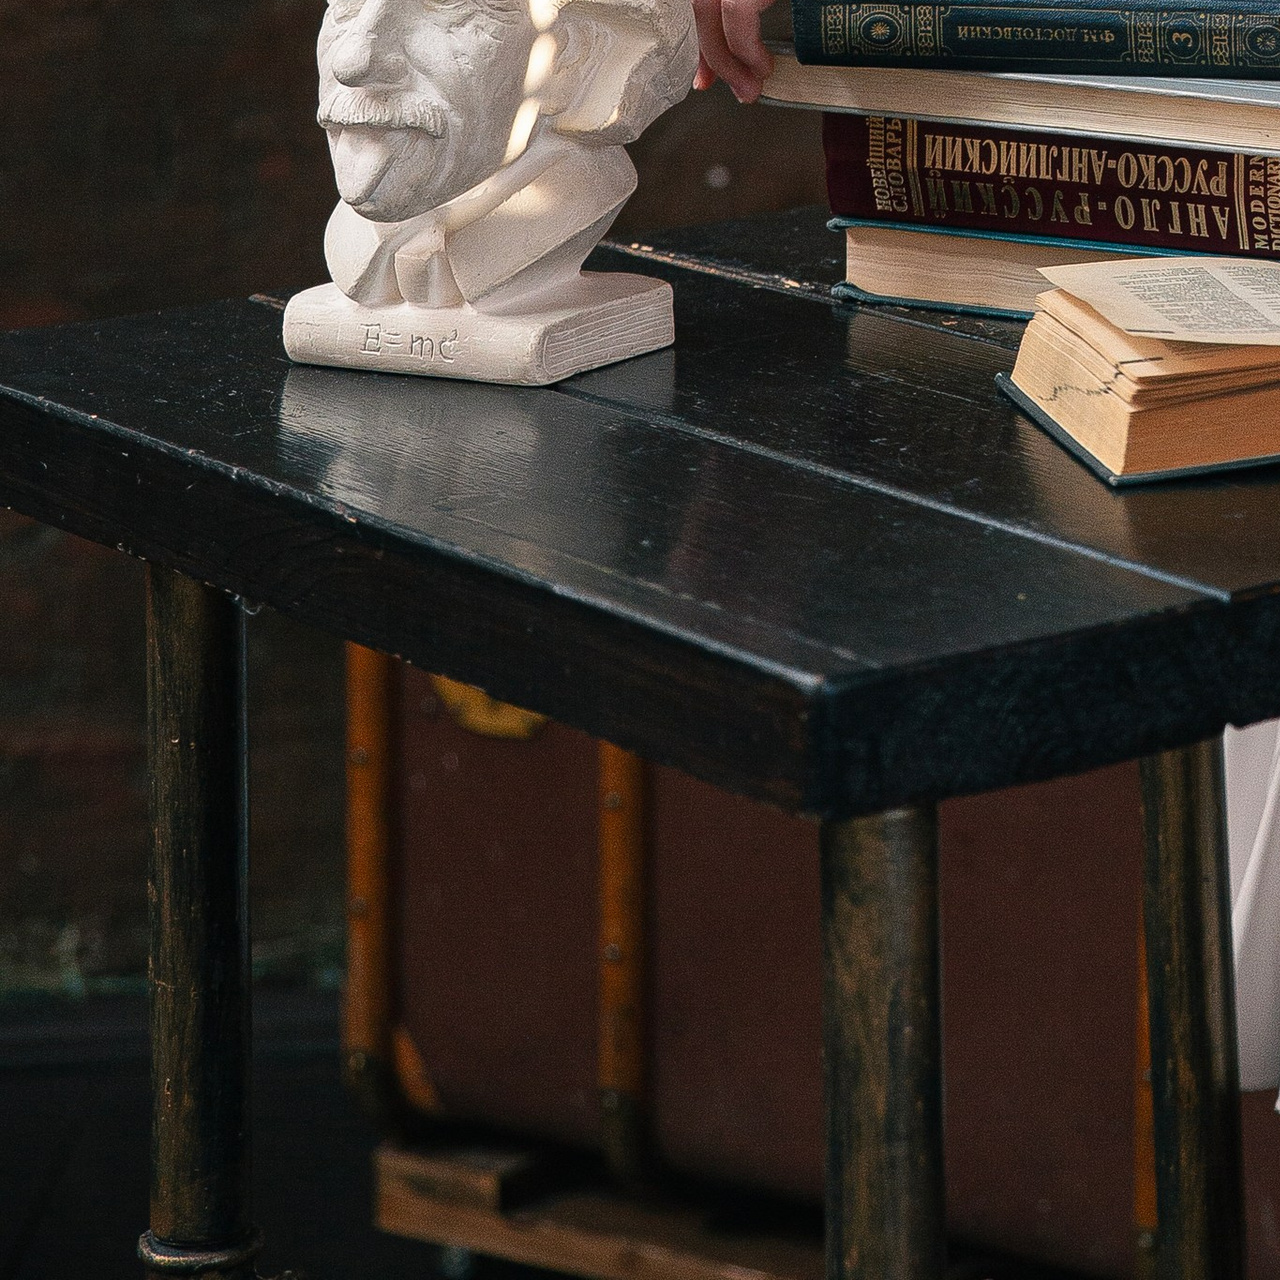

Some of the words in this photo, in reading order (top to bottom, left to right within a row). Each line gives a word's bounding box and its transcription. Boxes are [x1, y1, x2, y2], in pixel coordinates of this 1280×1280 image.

[957, 25, 1077, 42] ДОСТОЕВСКИЙ
[1172, 32, 1193, 47] 3
[866, 115, 893, 212] НОВЕЙШИЙ
[886, 118, 908, 213] СЛОВАРЬ
[924, 134, 1228, 198] РУССКО-АНГЛИЙСКИЙ
[1249, 155, 1270, 250] MODERN
